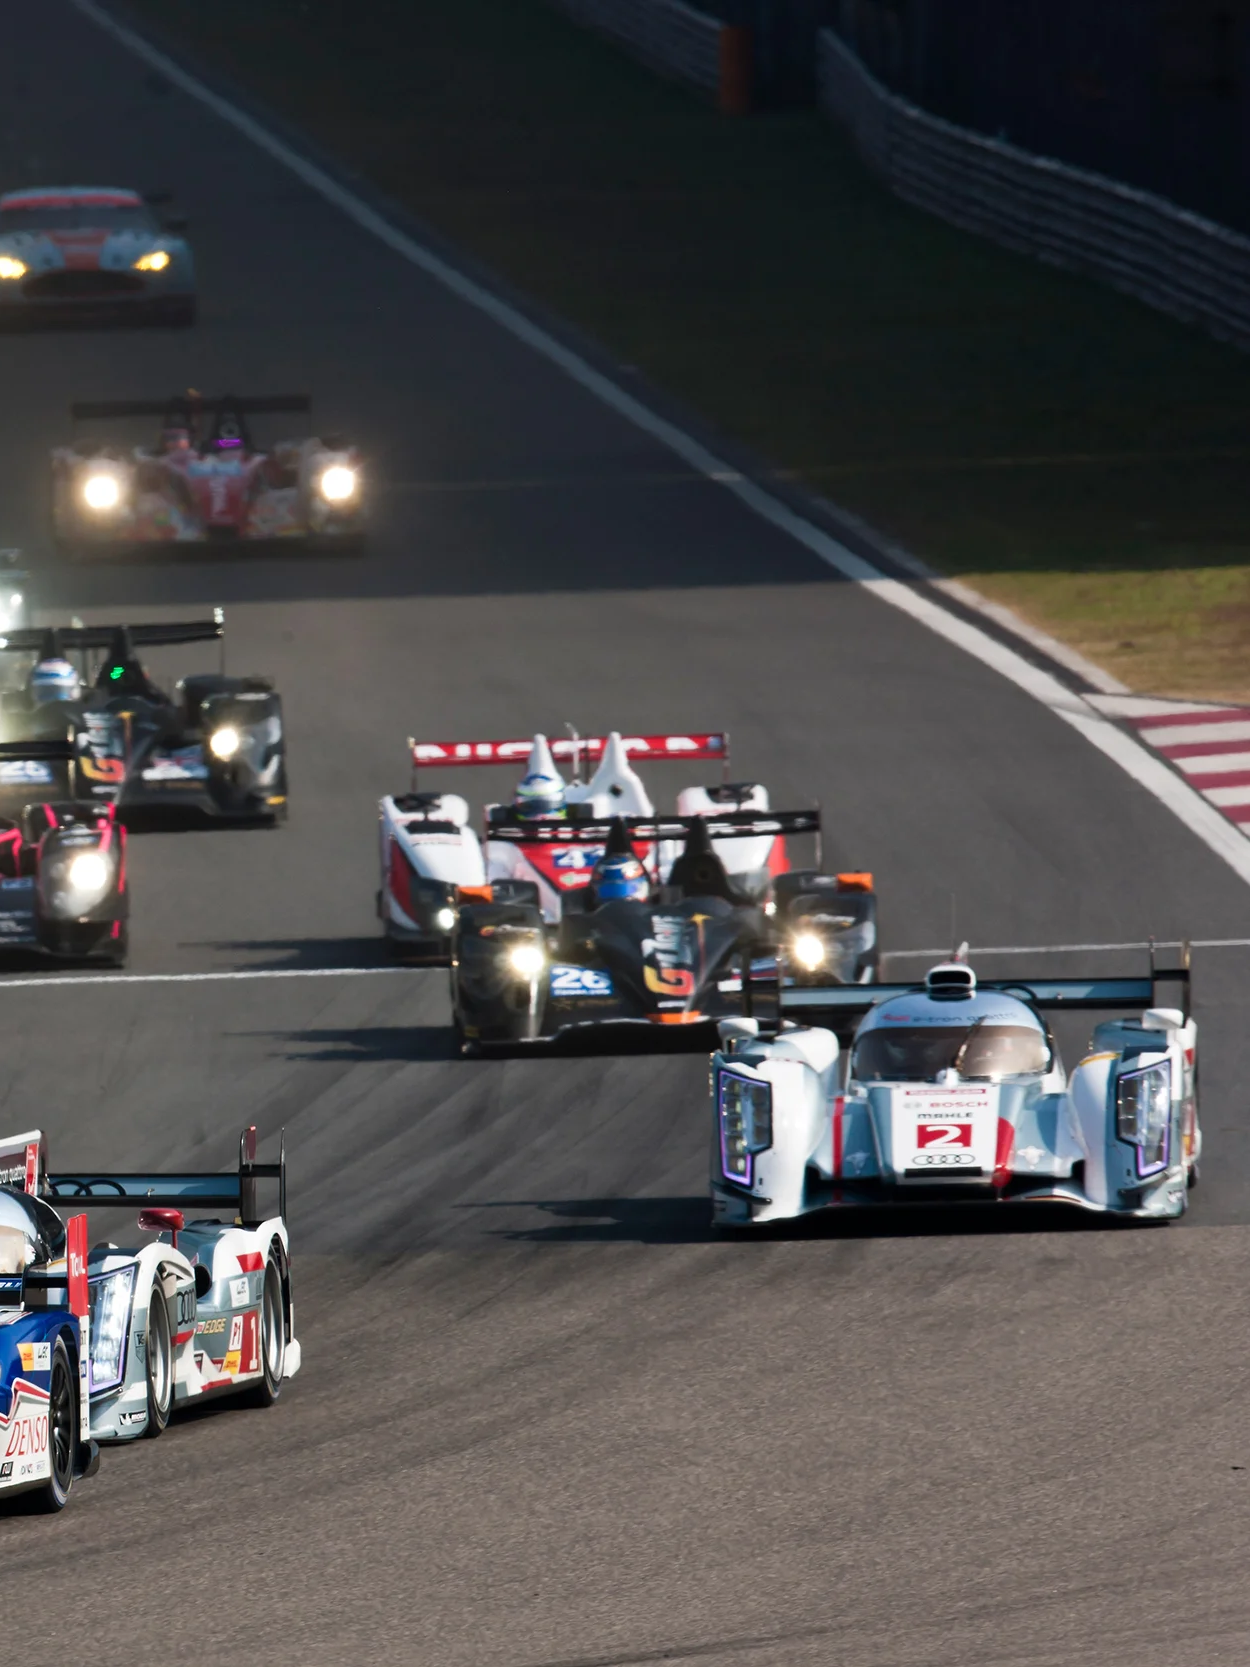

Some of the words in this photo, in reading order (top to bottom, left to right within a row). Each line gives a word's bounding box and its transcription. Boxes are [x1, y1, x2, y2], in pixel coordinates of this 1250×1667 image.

[552, 967, 611, 989] 26
[923, 1125, 964, 1148] 2
[204, 1318, 226, 1334] EDGE
[249, 1316, 258, 1370] 1
[5, 1415, 48, 1457] DENSO
